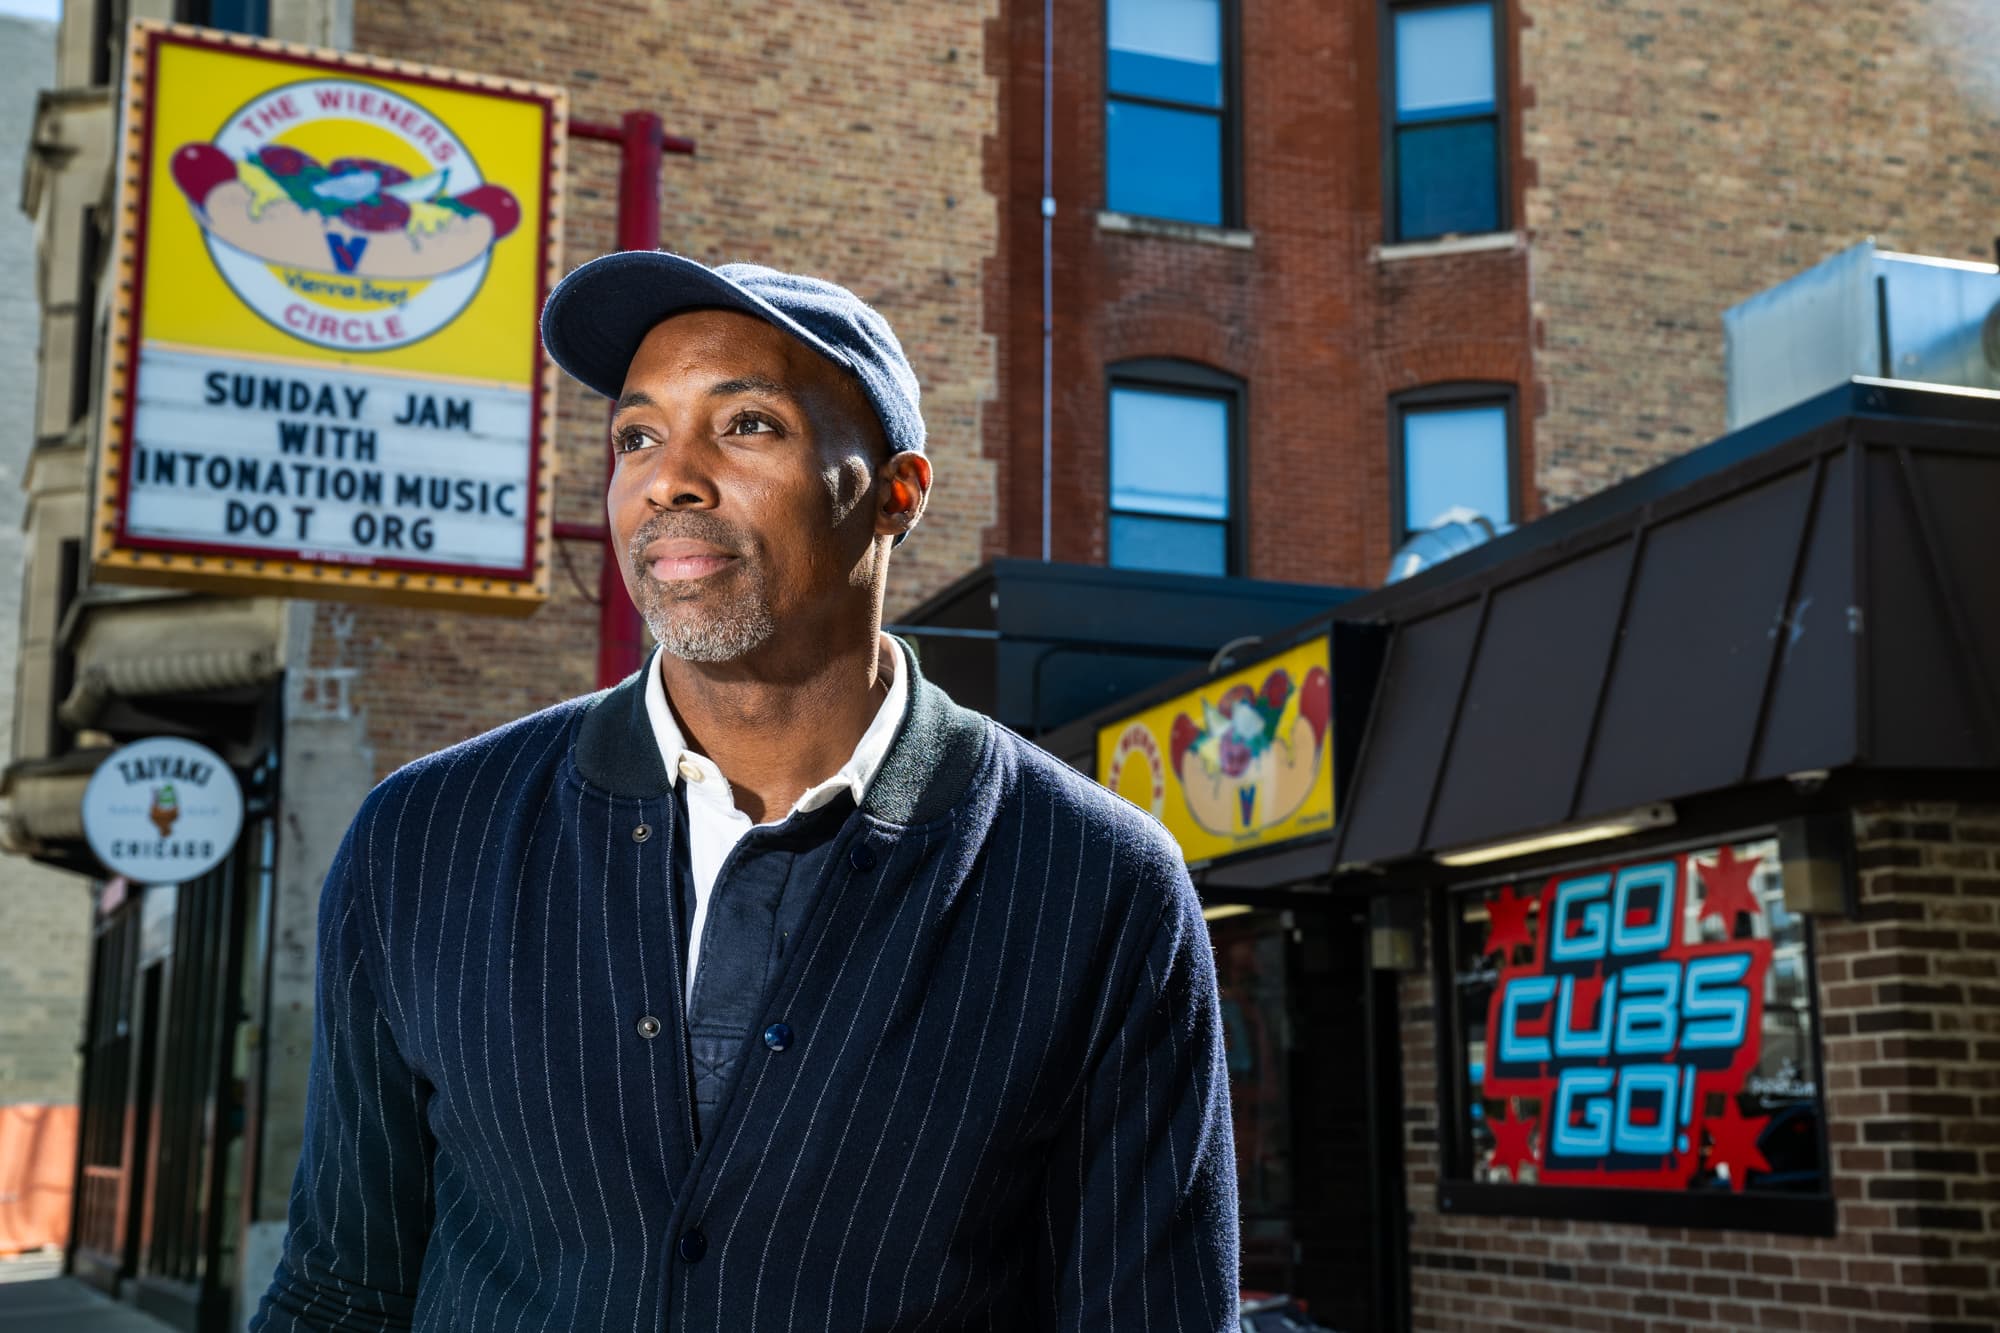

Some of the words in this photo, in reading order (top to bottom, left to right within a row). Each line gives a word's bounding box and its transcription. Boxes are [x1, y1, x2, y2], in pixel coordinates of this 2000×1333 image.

[239, 93, 299, 138] THE
[315, 88, 457, 163] WIENERS
[283, 303, 406, 343] CIRCLE
[205, 371, 367, 420] SUNDAY
[395, 395, 472, 432] JAM
[278, 421, 378, 462] WITH
[135, 447, 384, 507] INTONATION
[396, 475, 517, 518] MUSIC
[353, 512, 435, 551] ORG
[117, 755, 214, 787] TAIYAKI
[111, 838, 214, 859] CHICAGO
[1551, 859, 1678, 963] GO
[1500, 953, 1753, 1063] CUBS
[1552, 1063, 1697, 1157] GO!
